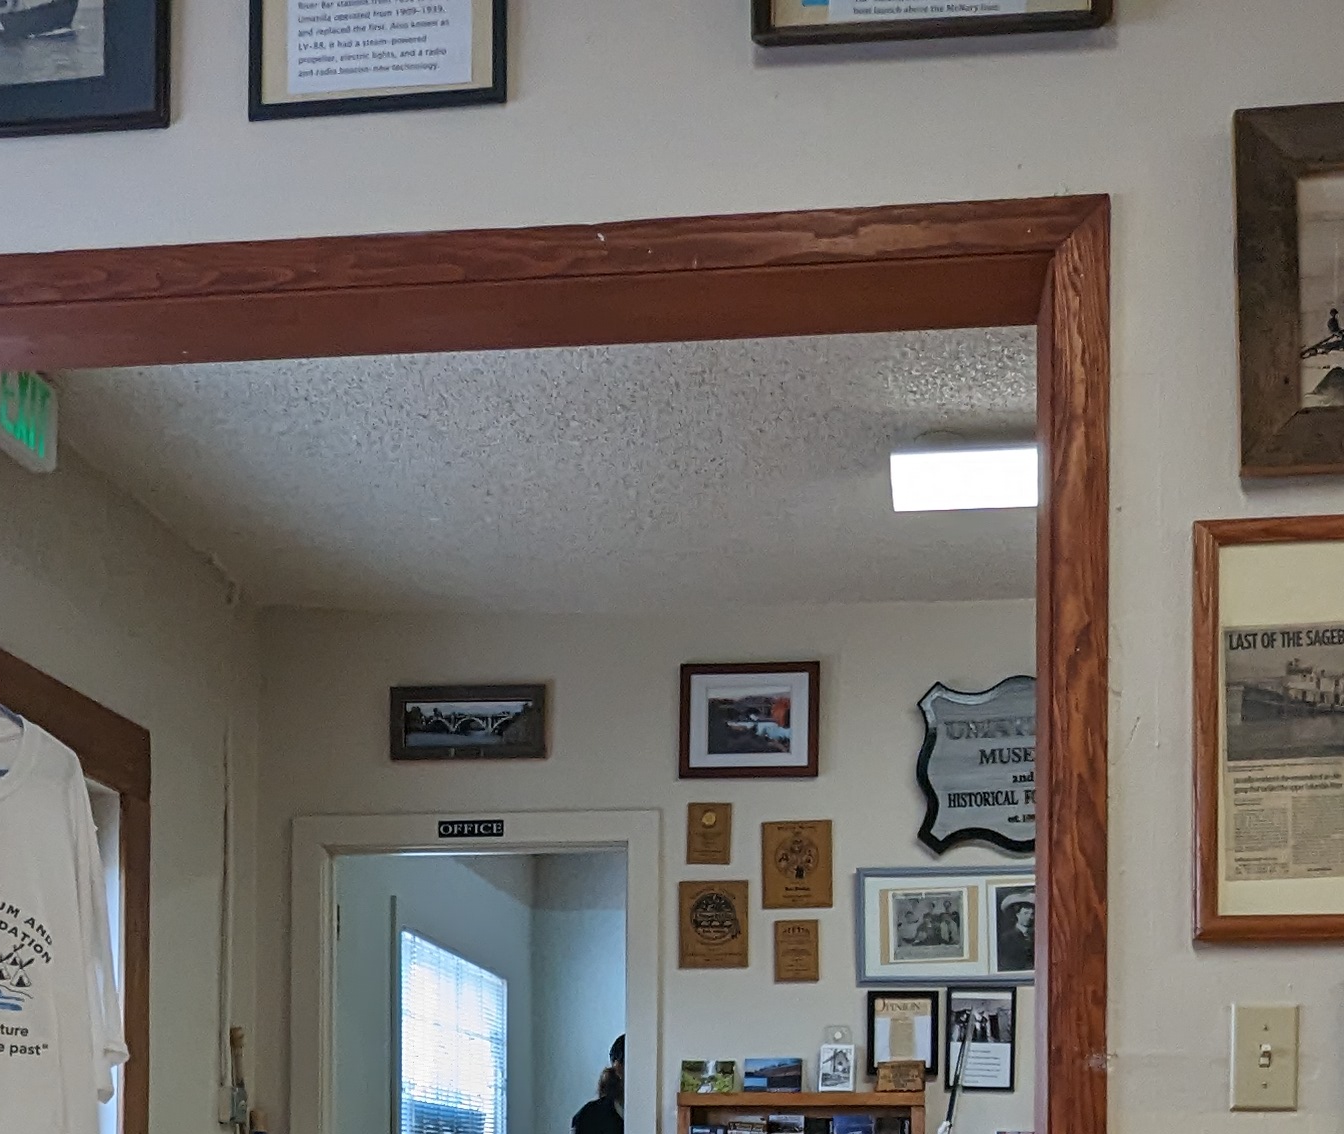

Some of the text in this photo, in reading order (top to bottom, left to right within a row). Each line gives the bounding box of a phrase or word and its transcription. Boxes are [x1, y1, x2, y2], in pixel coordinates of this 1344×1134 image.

[1228, 632, 1258, 650] LAST
[1260, 631, 1278, 649] OF
[1280, 629, 1303, 648] THE
[978, 746, 1035, 766] MUSE
[1012, 771, 1035, 783] and
[947, 790, 1019, 808] HISTORICAL
[439, 822, 503, 835] OFFICE
[23, 916, 54, 947] AND
